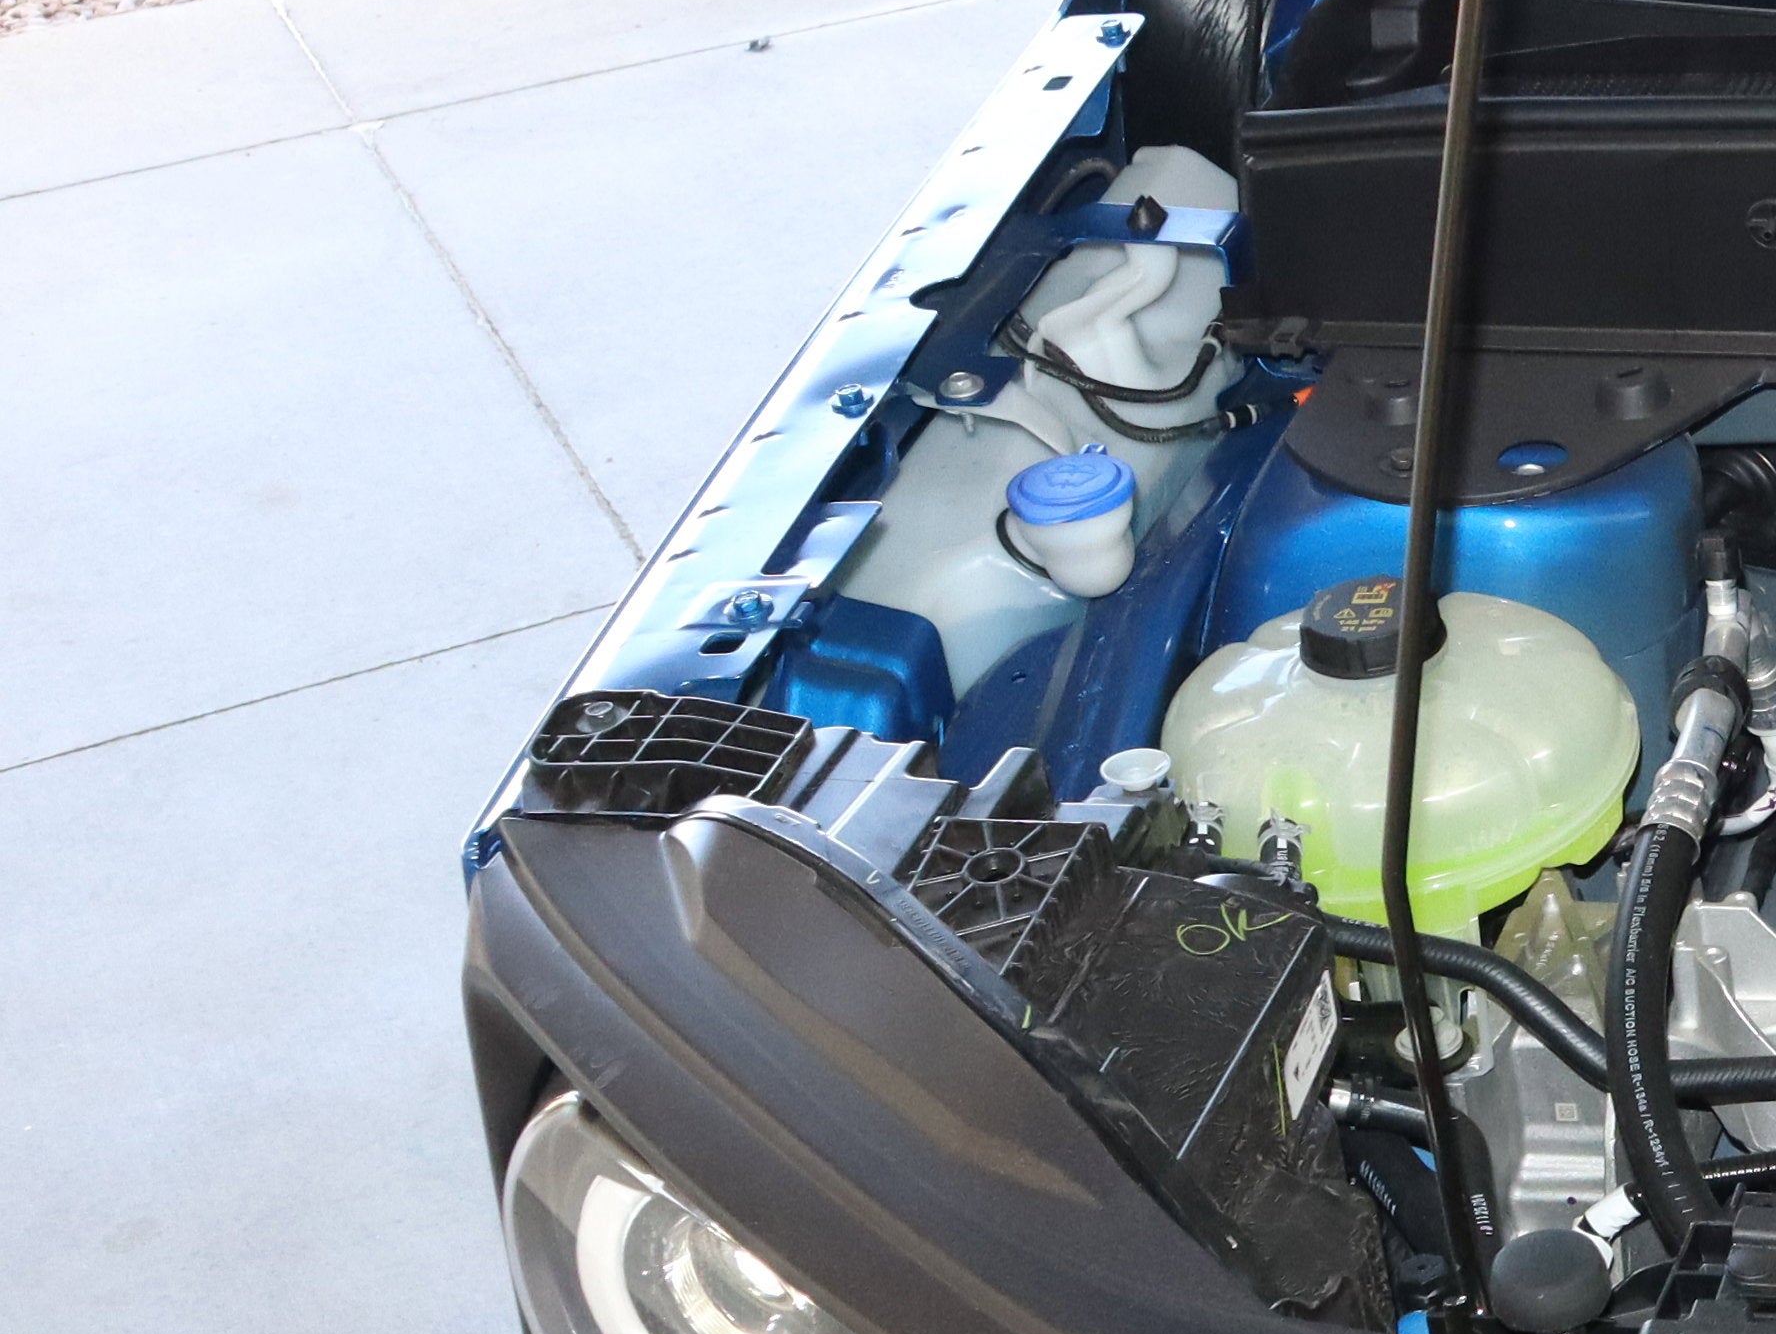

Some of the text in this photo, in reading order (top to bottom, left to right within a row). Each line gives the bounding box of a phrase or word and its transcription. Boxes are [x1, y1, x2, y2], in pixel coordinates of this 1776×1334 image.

[1625, 905, 1647, 963] Flexbarrier
[1624, 968, 1637, 986] A/C
[1624, 987, 1636, 1038] SUCTION
[1626, 1041, 1641, 1072] HOSE
[1631, 1073, 1648, 1112] R-134a
